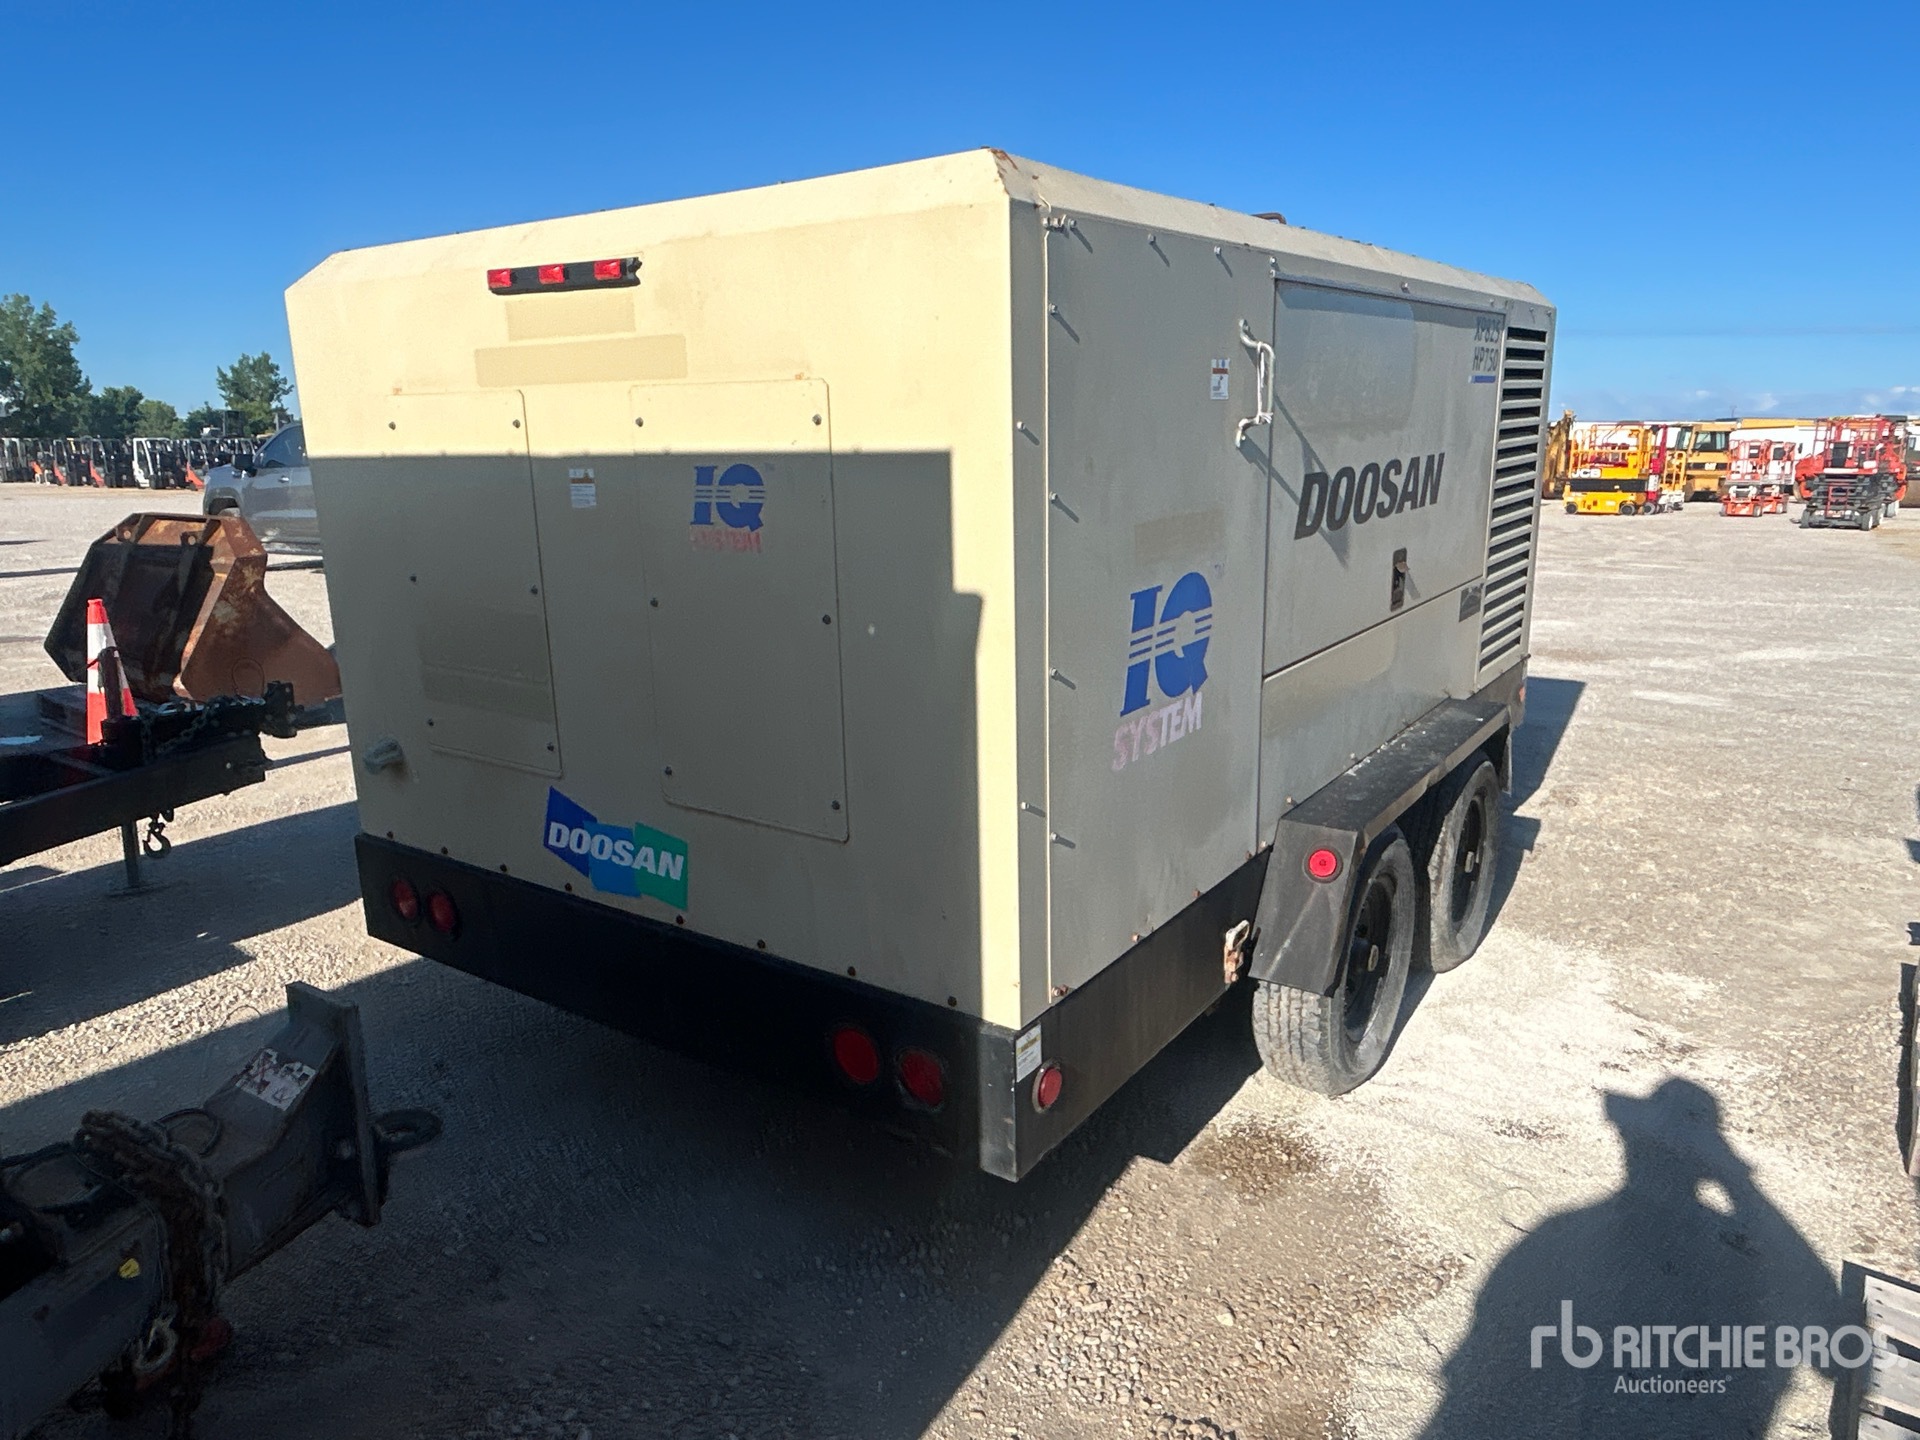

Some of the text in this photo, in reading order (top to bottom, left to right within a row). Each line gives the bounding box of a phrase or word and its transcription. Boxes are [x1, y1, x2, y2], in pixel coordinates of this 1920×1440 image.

[689, 463, 766, 532] IQ
[1294, 452, 1445, 540] DOOSAN
[1571, 468, 1602, 478] JCB
[1120, 571, 1213, 718] IQ
[1111, 691, 1203, 772] SYSTEM
[548, 821, 684, 881] DOOSAN
